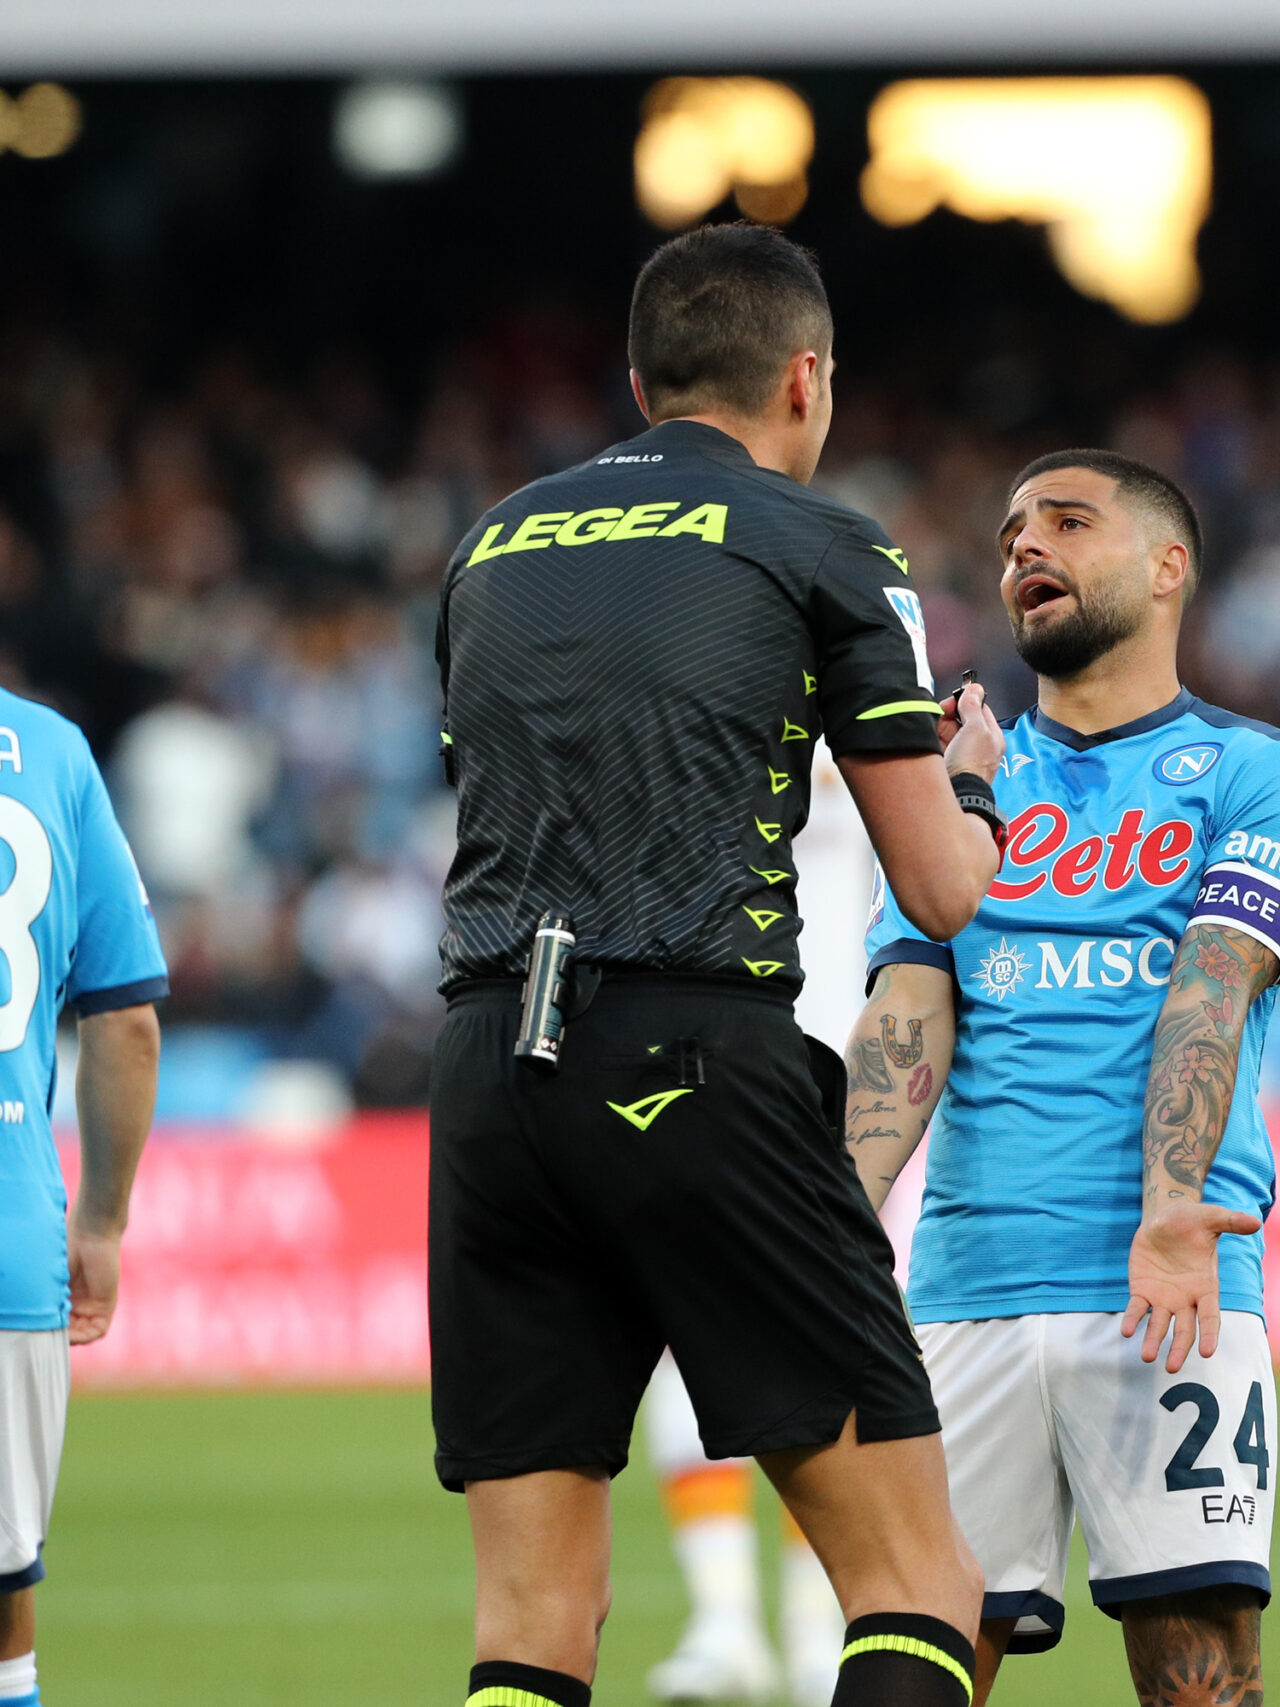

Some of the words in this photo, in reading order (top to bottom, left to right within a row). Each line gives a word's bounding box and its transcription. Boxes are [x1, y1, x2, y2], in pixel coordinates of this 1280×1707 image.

[597, 456, 615, 465] DI
[614, 454, 664, 464] BELLO
[466, 501, 729, 568] LEGEA
[1193, 883, 1280, 923] PEACE
[1034, 937, 1177, 989] MSC
[1158, 1380, 1270, 1493] 24
[1201, 1494, 1256, 1526] EA7
